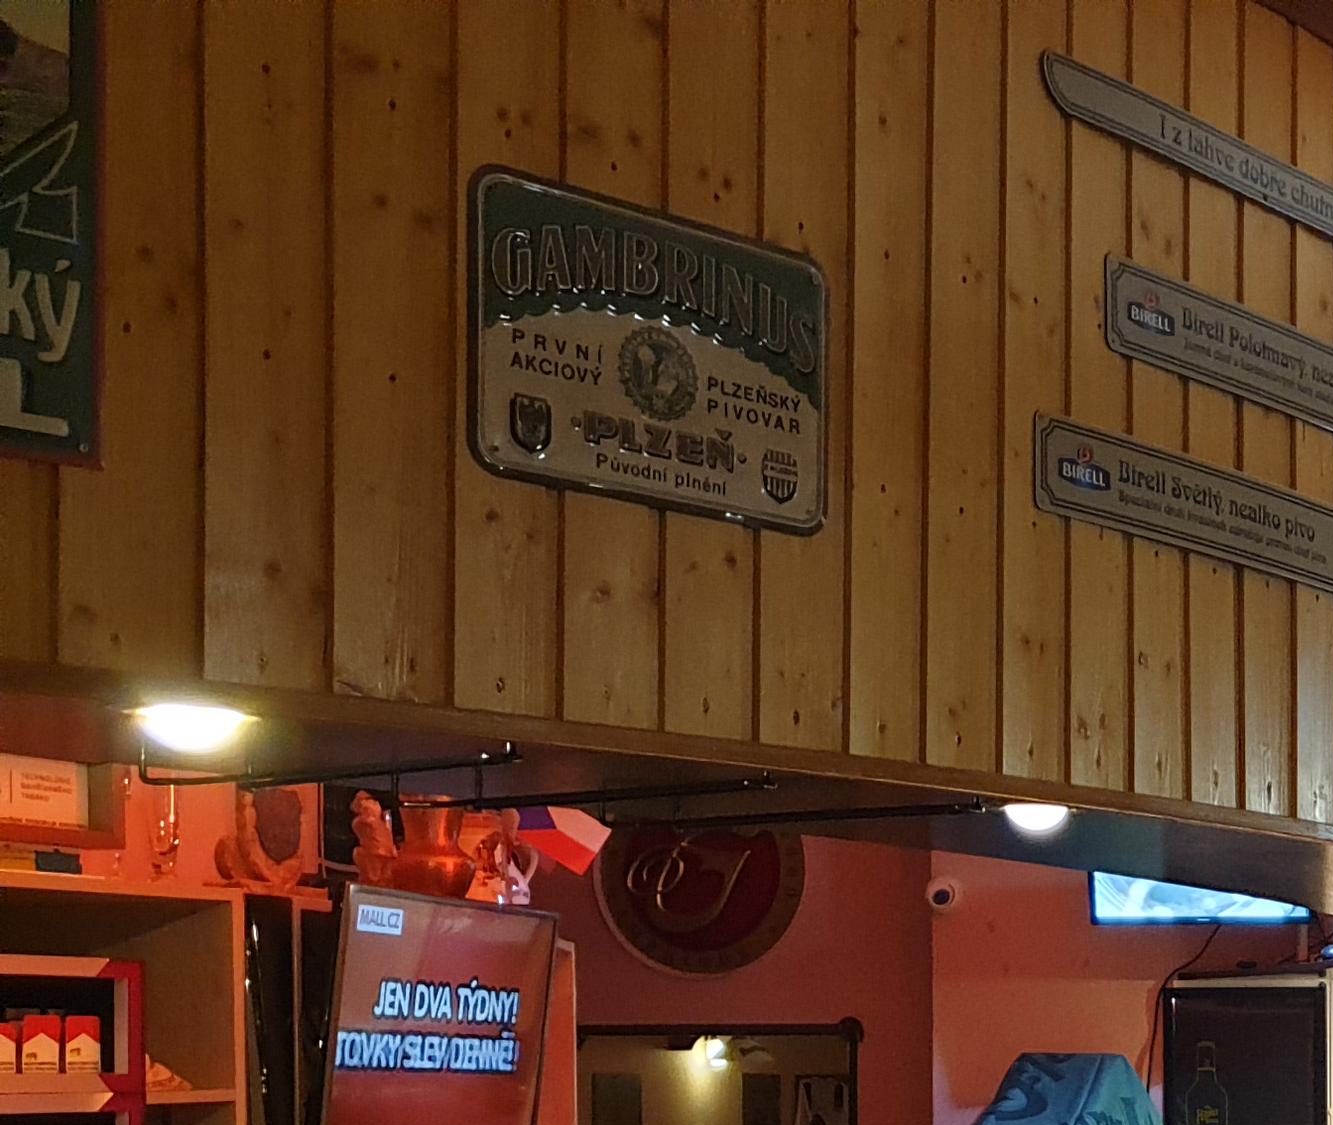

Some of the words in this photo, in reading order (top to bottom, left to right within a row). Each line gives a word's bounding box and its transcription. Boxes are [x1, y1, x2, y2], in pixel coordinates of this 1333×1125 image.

[490, 224, 817, 374] GAMBRINUS
[1130, 304, 1171, 333] BIRELL
[1182, 306, 1225, 344] Birell
[511, 327, 603, 365] PRVNÍ
[510, 351, 603, 387] AKCIOVÝ
[706, 375, 802, 413] PLZEŇSKÝ
[706, 399, 801, 435] PIVOVAR
[595, 451, 668, 483] Původní
[1061, 461, 1107, 488] BIRELL
[1118, 459, 1167, 496] Birell
[1228, 499, 1281, 531] nealko
[372, 979, 412, 1018] JEN
[413, 982, 452, 1020] DVA
[456, 975, 520, 1025] TÝDNY!
